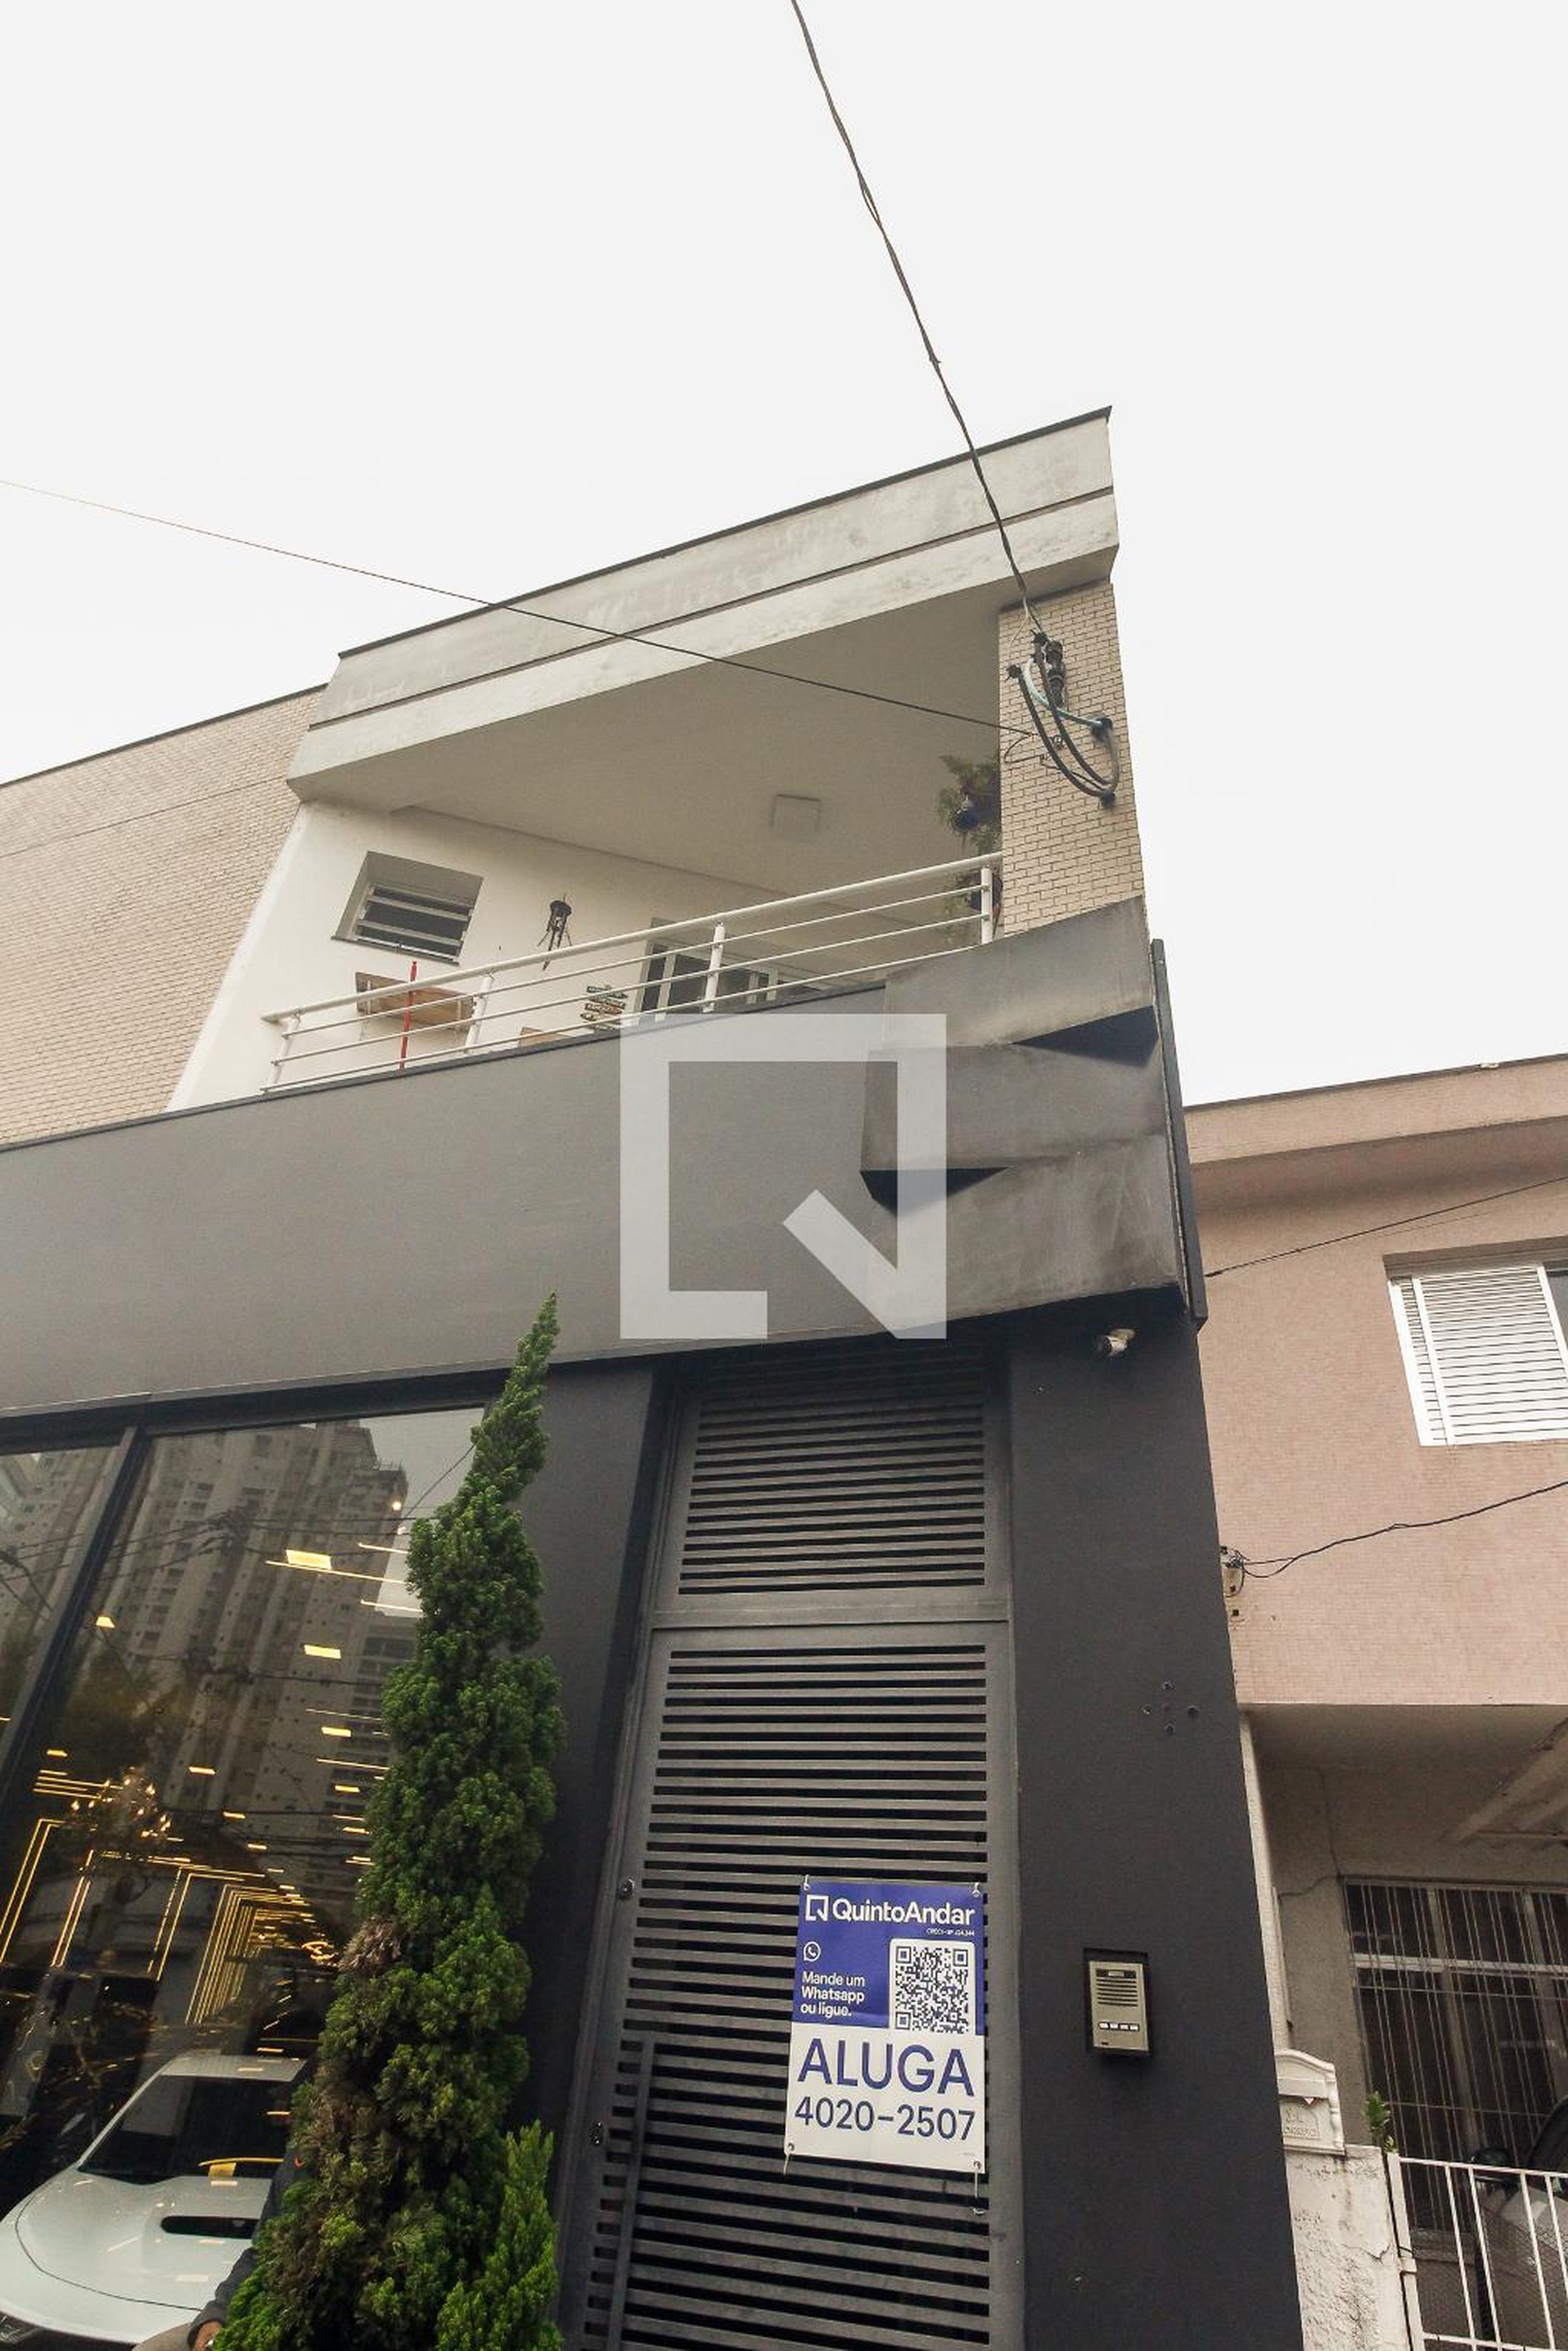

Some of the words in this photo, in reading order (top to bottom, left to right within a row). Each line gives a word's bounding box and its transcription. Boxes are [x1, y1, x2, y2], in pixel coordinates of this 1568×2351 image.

[833, 1898, 976, 1925] QuintoAndar
[802, 1971, 843, 1985] Mande
[846, 1976, 865, 1987] um
[802, 1985, 865, 2004] Whatsapp
[800, 2003, 816, 2014] ou
[818, 2002, 852, 2018] ligue.
[797, 2038, 975, 2097] ALUGA
[794, 2097, 976, 2141] 4020-2507
